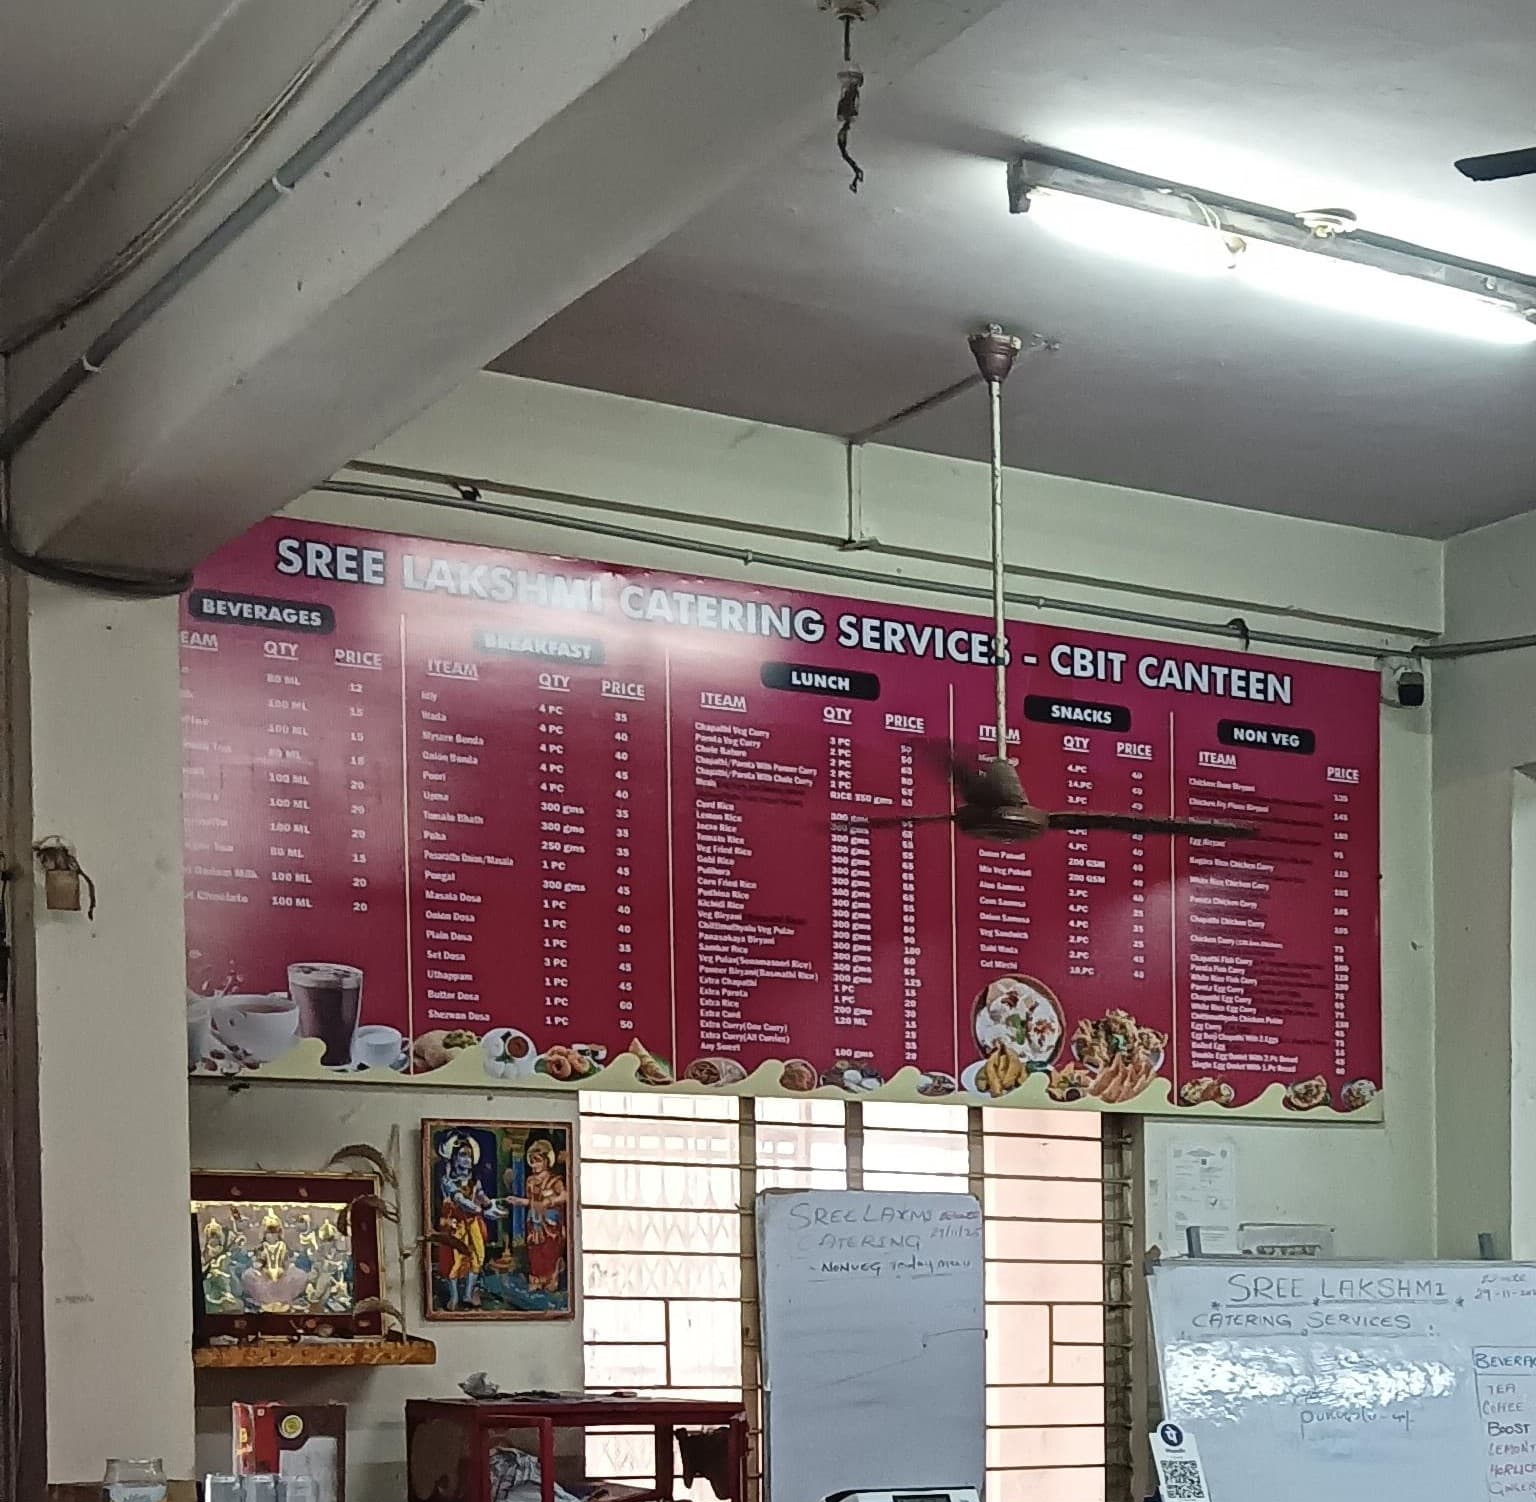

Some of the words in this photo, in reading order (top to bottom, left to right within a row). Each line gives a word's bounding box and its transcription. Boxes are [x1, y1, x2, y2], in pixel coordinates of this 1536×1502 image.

[202, 598, 322, 627] BEVERAGES
[277, 538, 386, 585] SREE
[403, 555, 601, 610] LAKSHMI
[620, 586, 825, 642] CATERING
[838, 615, 1012, 667] SERVICES
[1050, 645, 1126, 681] CBIT
[1138, 656, 1292, 704] CANTEEN
[180, 630, 218, 647] EAM
[263, 640, 299, 657] QTY
[334, 649, 383, 667] PRICE
[427, 658, 478, 677] ITEAM
[538, 673, 571, 688] QTY
[601, 680, 645, 697] PRICE
[791, 671, 850, 691] LUNCH
[700, 692, 747, 709] ITEAM
[823, 707, 852, 721] QTY
[885, 713, 925, 730] PRICE
[1050, 705, 1113, 724] SNACKS
[979, 725, 1021, 740] ITEM
[1063, 736, 1090, 750] QTY
[1116, 742, 1152, 756] PRICE
[1233, 728, 1267, 744] NON
[1272, 732, 1300, 747] VEG
[1199, 751, 1237, 766] ITEAM
[1327, 767, 1360, 780] PRICE
[295, 898, 313, 908] ML
[353, 902, 368, 912] 20
[460, 892, 481, 903] Dosa
[617, 905, 631, 915] 40
[453, 912, 475, 923] Dosa
[553, 920, 567, 929] PC
[617, 924, 631, 934] 40
[444, 951, 465, 961] Dosa
[554, 959, 568, 968] PC
[457, 991, 480, 1002] Dosa
[468, 1011, 490, 1022] Dosa
[1227, 1274, 1304, 1302] SREE
[1321, 1278, 1446, 1299] LAKSHMI
[1192, 1313, 1292, 1328] CATERING
[1306, 1311, 1411, 1329] SERVICES
